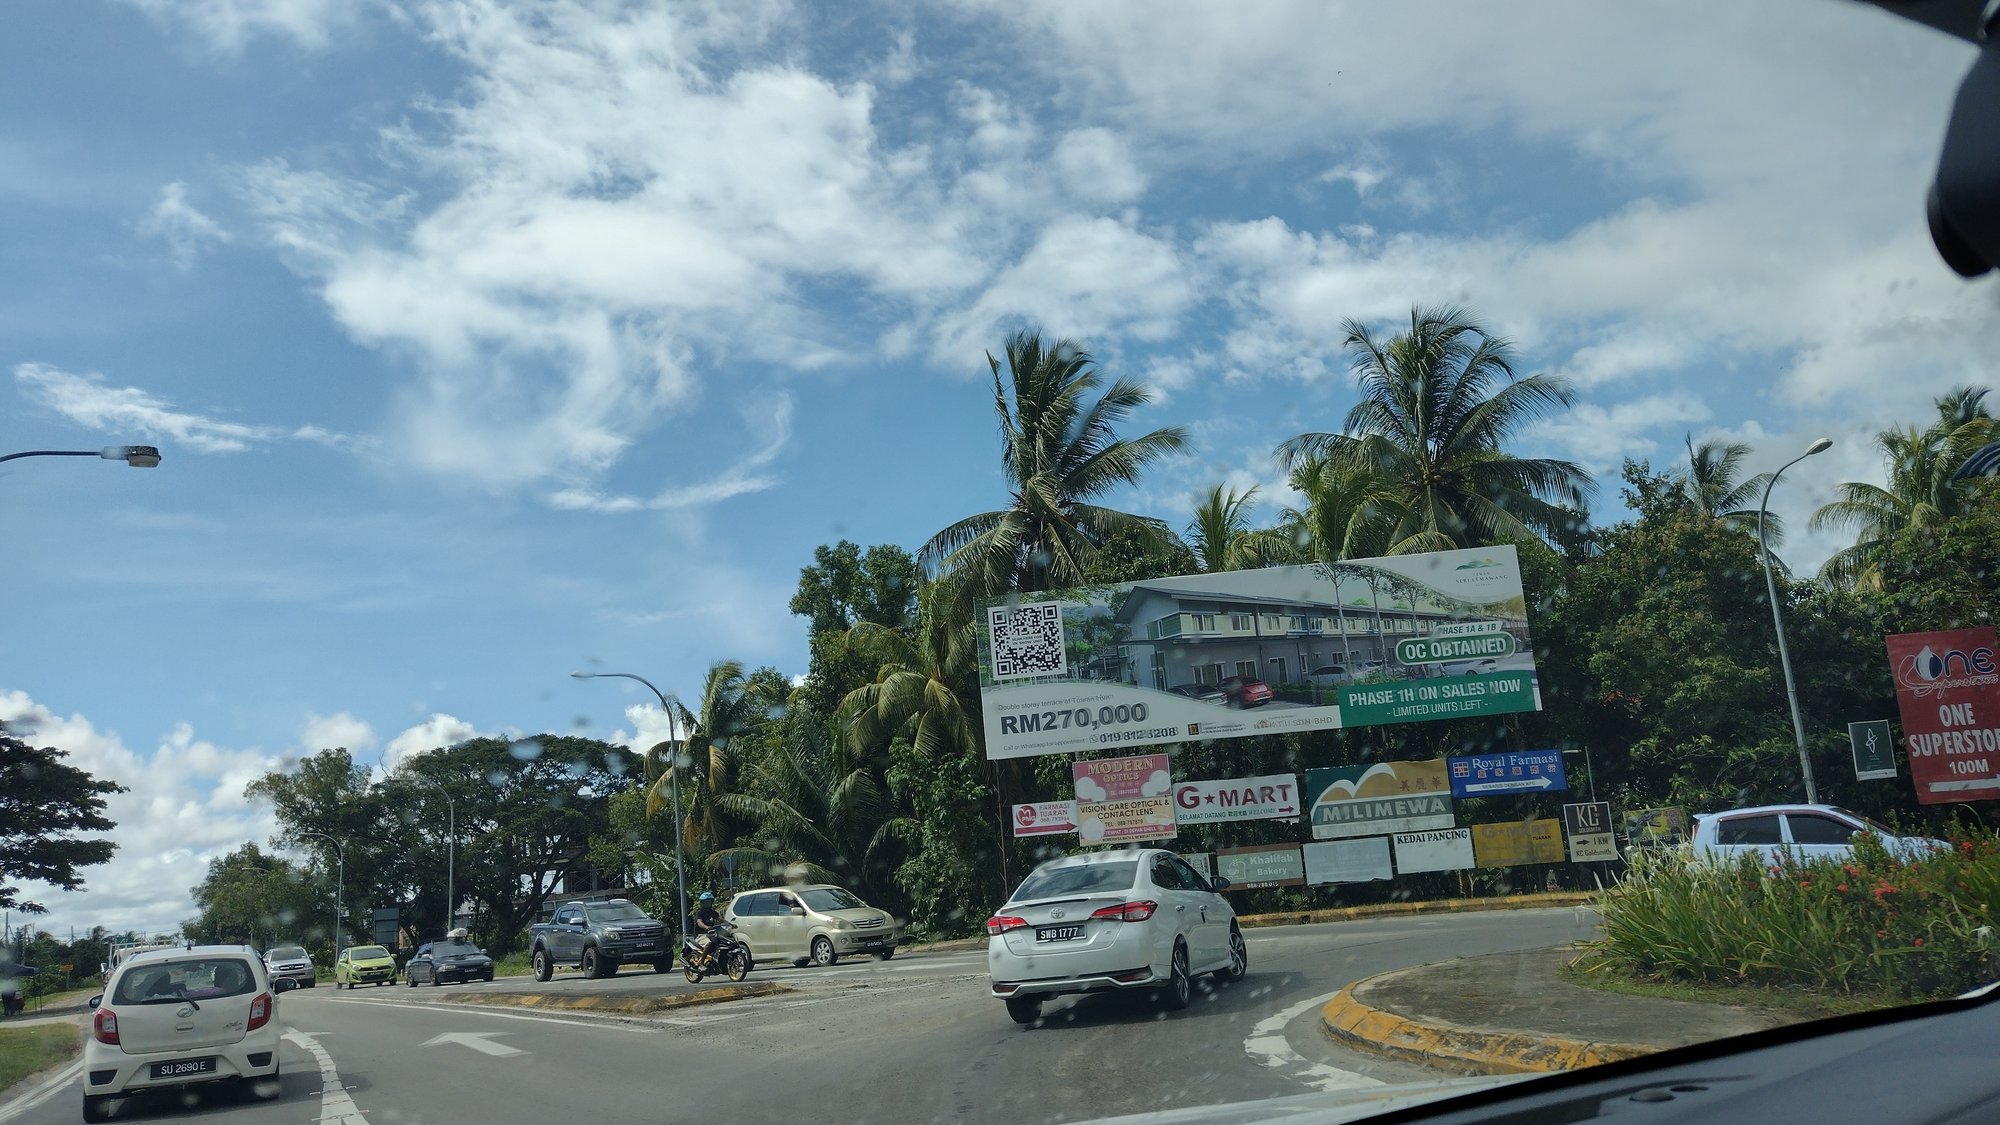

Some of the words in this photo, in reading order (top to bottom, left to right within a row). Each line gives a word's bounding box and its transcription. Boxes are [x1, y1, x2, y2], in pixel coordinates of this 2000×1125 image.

[1466, 625, 1476, 634] 1A
[1478, 624, 1484, 632] &
[1486, 623, 1497, 632] 1B
[1405, 643, 1426, 660] OC
[1430, 638, 1506, 658] OBTAINED
[1349, 690, 1393, 706] PHASE
[1397, 688, 1414, 702] 1H
[1419, 686, 1438, 700] ON
[1442, 683, 1485, 698] SALES
[1489, 679, 1521, 694] NOW
[1021, 701, 1040, 709] storey
[1393, 704, 1429, 717] LIMITED
[1432, 702, 1458, 714] UNITS
[1461, 700, 1482, 711] LEFT
[1000, 702, 1147, 735] RM270,000
[1314, 717, 1332, 725] BHD
[1939, 703, 1976, 728] ONE
[1100, 731, 1121, 743] 019
[1123, 730, 1145, 741] 812
[1088, 758, 1155, 775] MODERN
[1472, 756, 1506, 770] Royal
[1509, 752, 1558, 766] Farmasi
[1949, 759, 1989, 775] 100M
[1103, 772, 1140, 783] OPTICS
[1039, 803, 1070, 811] FARMASI
[1080, 804, 1105, 814] VISION
[1108, 802, 1129, 811] CARE
[1131, 800, 1162, 809] OPTICAL
[1098, 810, 1134, 820] CONTACT
[1136, 808, 1154, 816] LENS
[1322, 797, 1446, 822] MILIMEWA
[1576, 805, 1599, 828] KC
[1397, 832, 1426, 845] KEDAI
[1427, 830, 1468, 843] PANCING
[1250, 854, 1294, 865] Khalifah
[1585, 848, 1612, 857] Goldsmith
[1257, 866, 1288, 876] Bakery
[1040, 928, 1057, 939] SWB
[1059, 927, 1079, 938] 1777
[161, 1064, 173, 1075] SU
[175, 1062, 198, 1073] 2690
[200, 1061, 206, 1070] E
